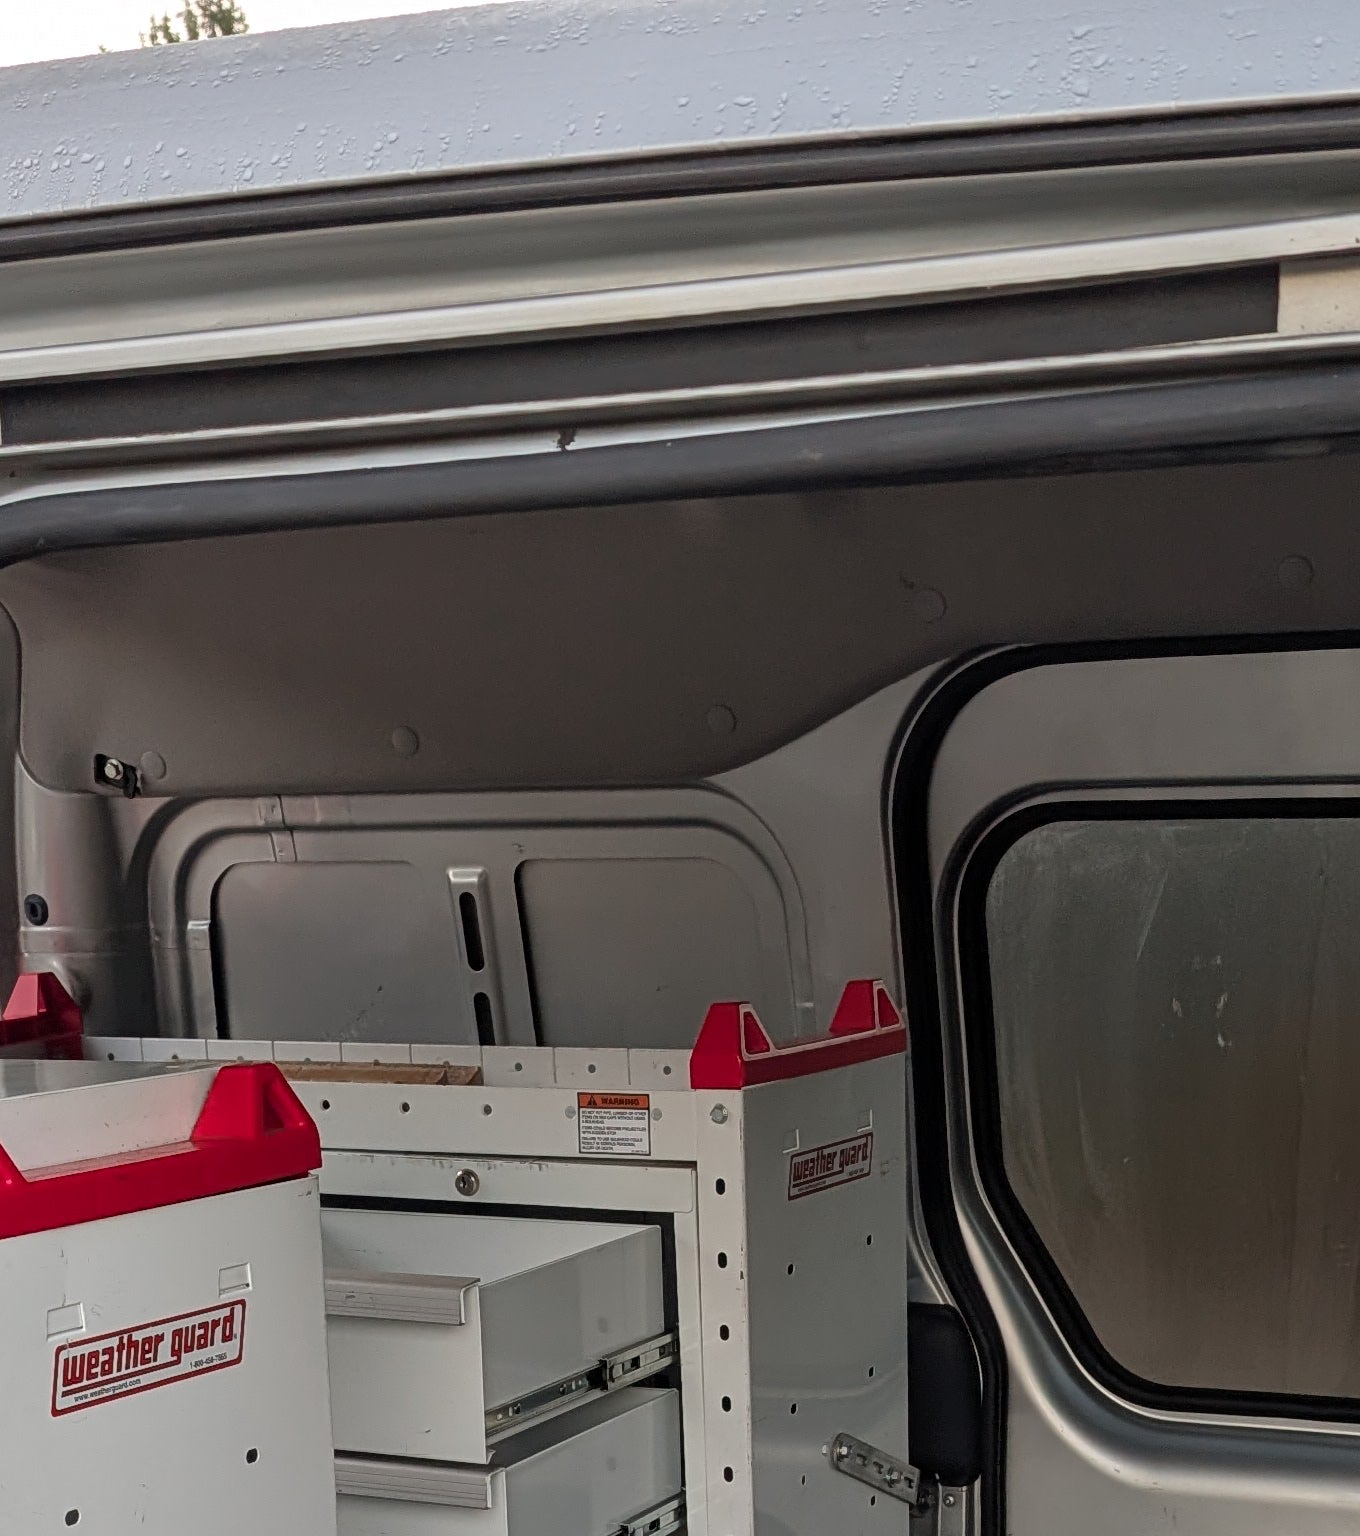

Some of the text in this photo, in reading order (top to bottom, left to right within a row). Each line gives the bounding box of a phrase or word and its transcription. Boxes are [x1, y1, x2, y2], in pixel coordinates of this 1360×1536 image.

[792, 1136, 869, 1181] weather guard
[62, 1307, 235, 1388] weather guard
[74, 1379, 142, 1402] www.weatherguard.com
